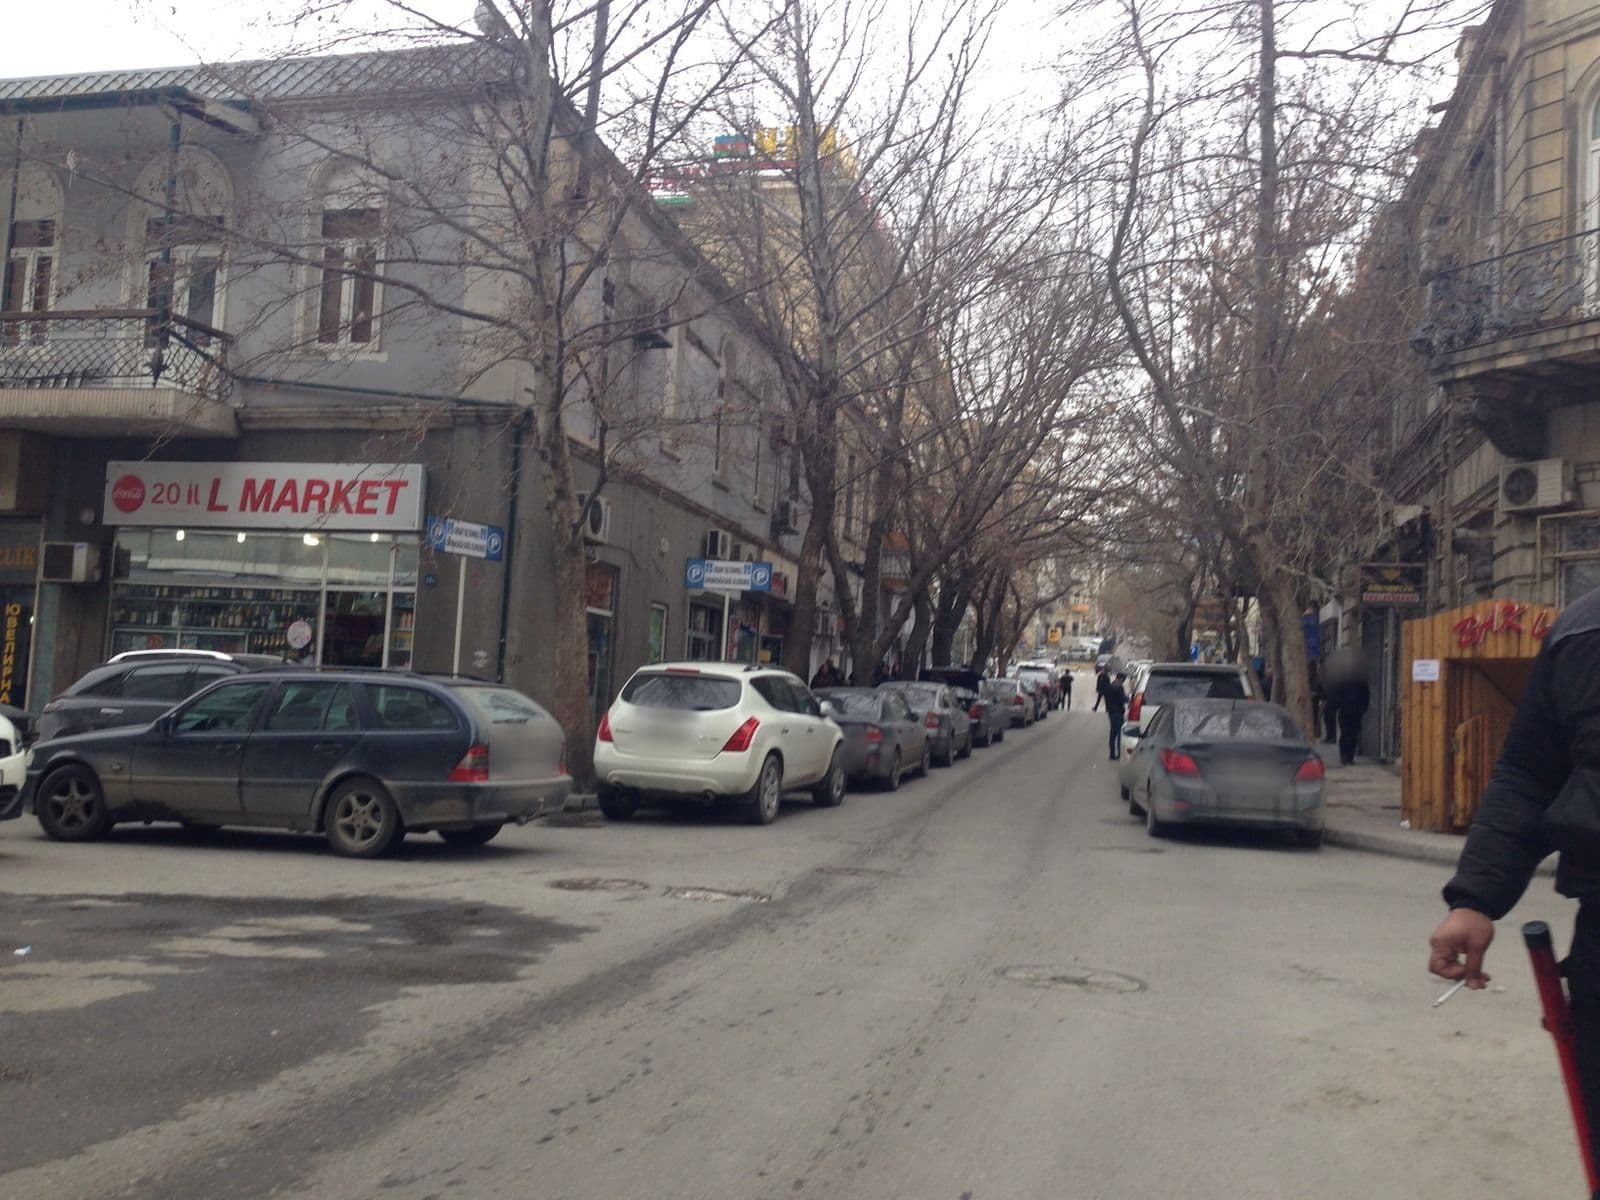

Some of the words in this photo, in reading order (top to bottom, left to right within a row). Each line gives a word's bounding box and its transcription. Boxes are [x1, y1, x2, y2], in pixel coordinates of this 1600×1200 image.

[151, 481, 181, 505] 20
[206, 478, 228, 512] L
[239, 478, 409, 516] MARKET
